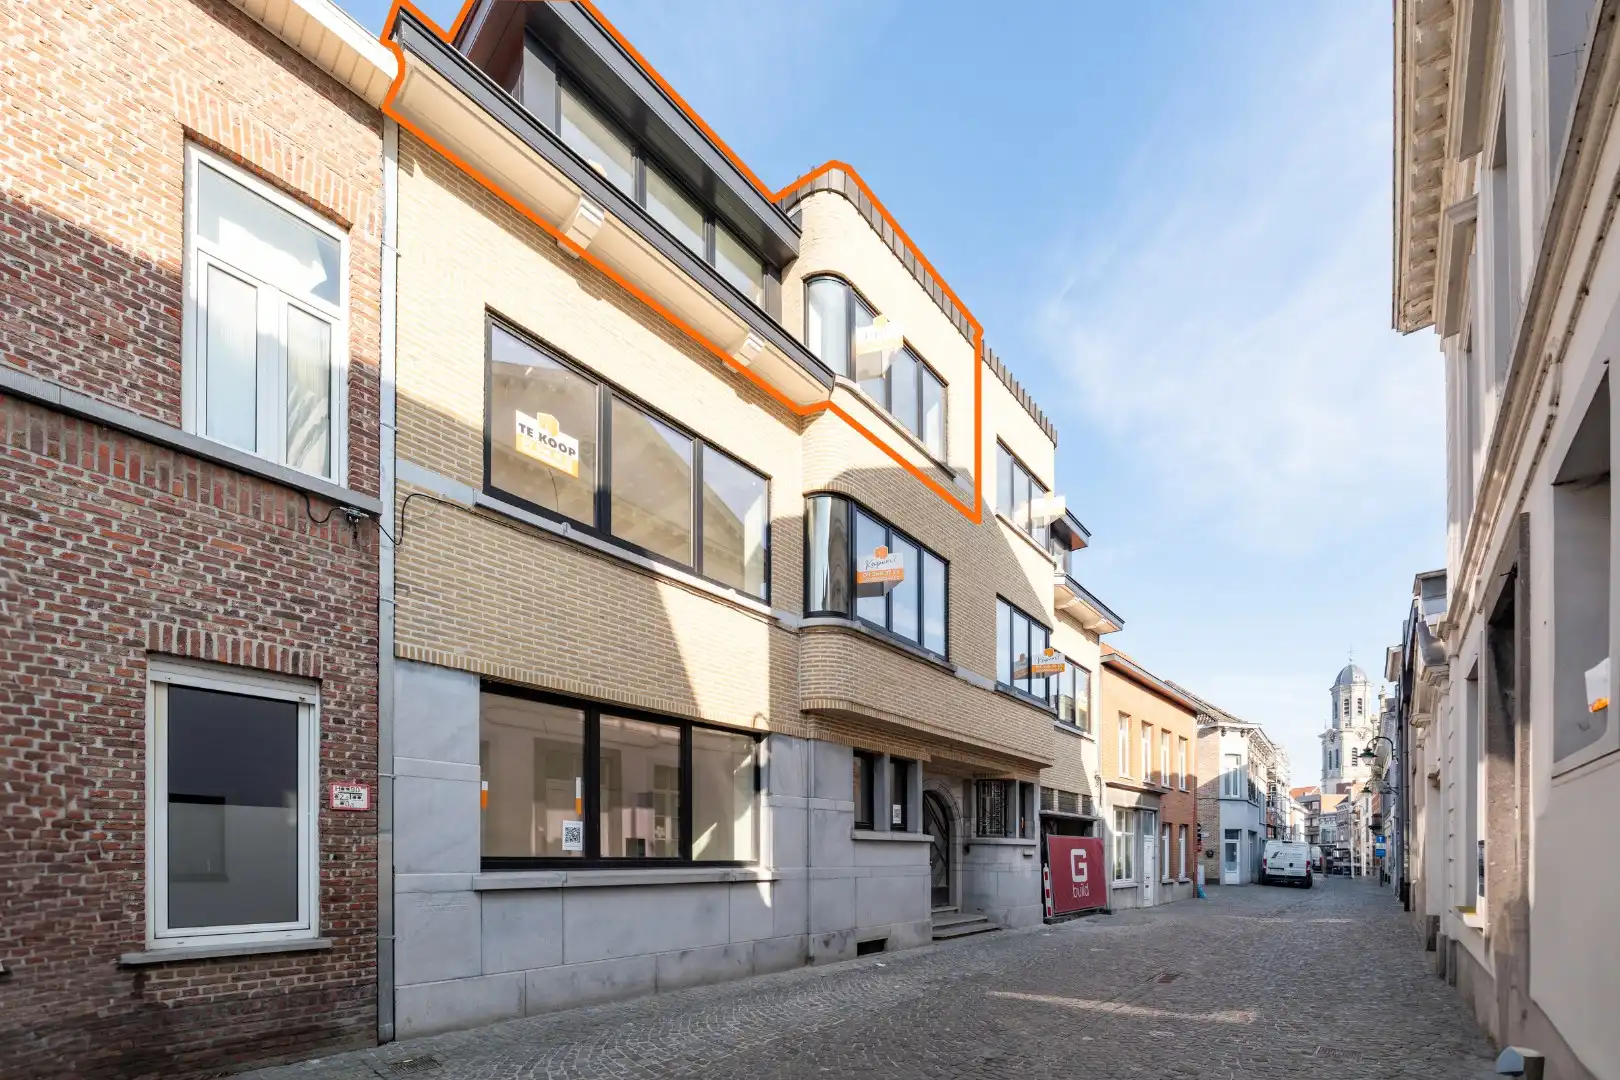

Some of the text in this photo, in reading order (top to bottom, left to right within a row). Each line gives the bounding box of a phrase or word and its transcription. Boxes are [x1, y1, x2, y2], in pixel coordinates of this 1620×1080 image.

[518, 423, 534, 438] TE
[538, 431, 576, 457] KOOP
[1070, 848, 1088, 883] G
[1072, 883, 1090, 898] build
